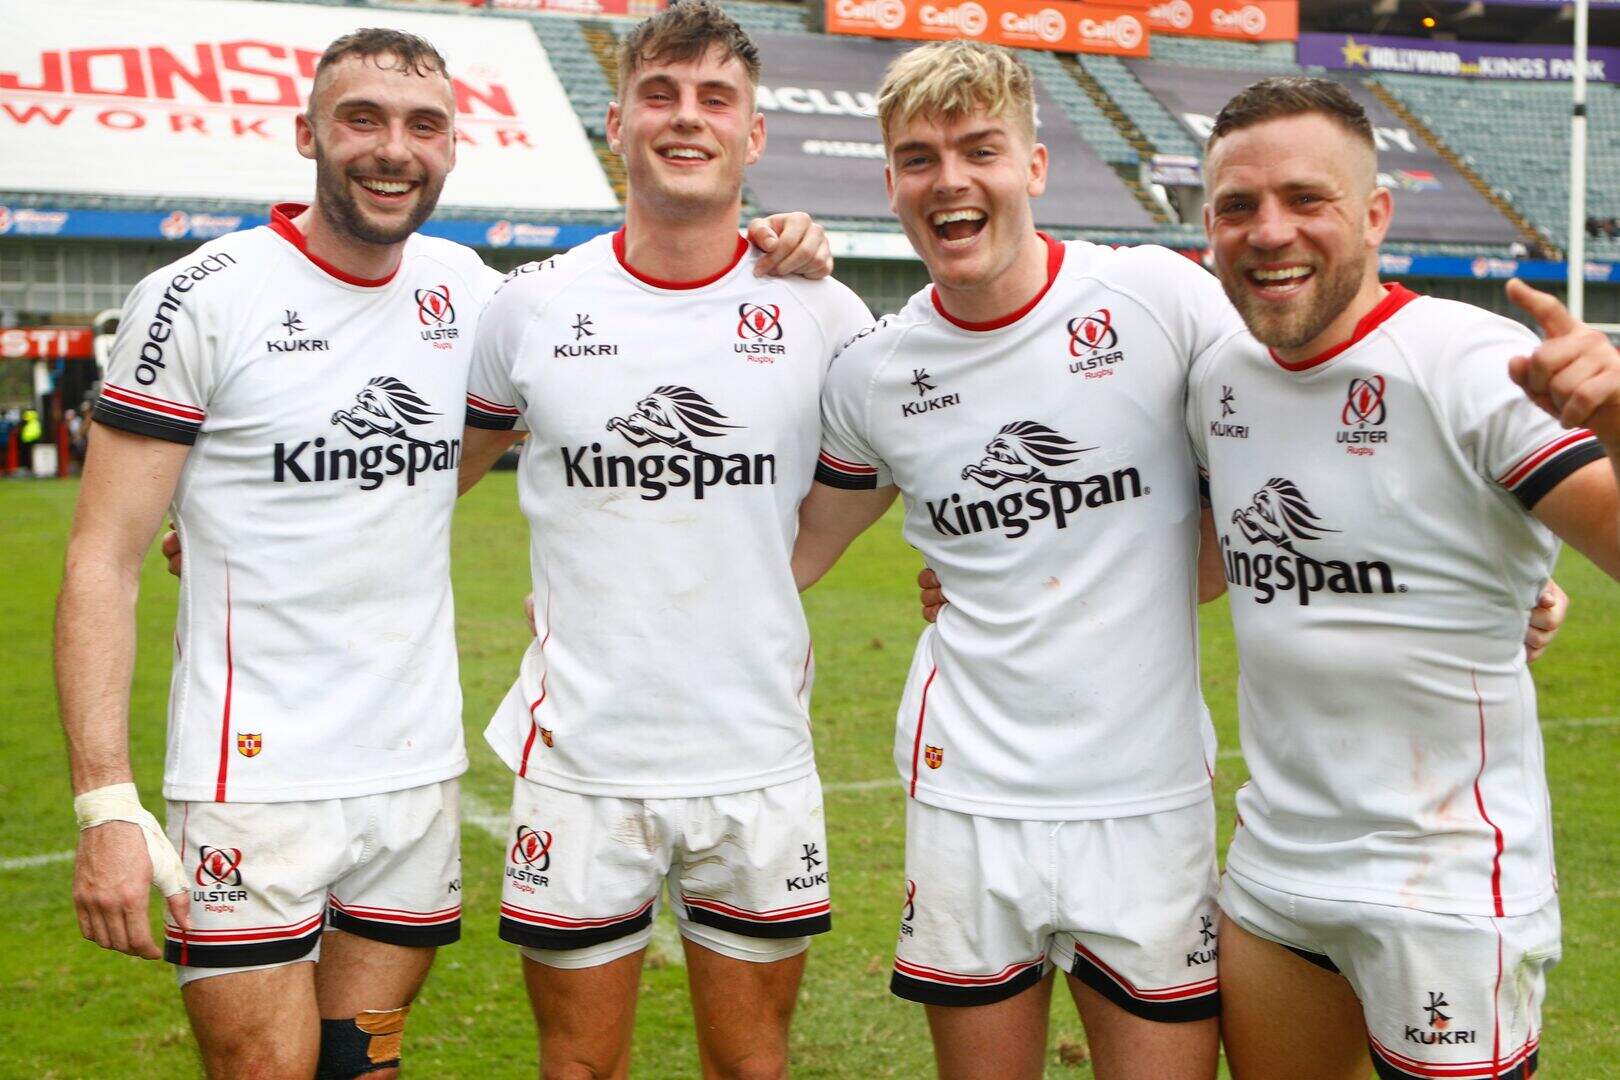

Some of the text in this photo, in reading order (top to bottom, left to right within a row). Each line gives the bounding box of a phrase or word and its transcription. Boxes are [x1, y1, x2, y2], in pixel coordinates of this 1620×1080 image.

[0, 40, 516, 117] JONSN
[1479, 57, 1547, 79] KINGS
[1550, 58, 1606, 80] PAK
[135, 252, 237, 386] openreach
[420, 328, 460, 341] ULSTER
[266, 339, 330, 352] KUKRI
[554, 344, 619, 358] KUKRI
[734, 342, 786, 356] ULSTER
[746, 354, 776, 365] Rugby
[1069, 350, 1124, 374] ULSTER
[1084, 368, 1114, 380] Rugby
[902, 392, 961, 417] KUKRI
[1210, 420, 1250, 438] KUKRI
[1336, 430, 1388, 443] ULSTER
[273, 436, 460, 491] Kingspan
[560, 441, 776, 501] Kingspan
[925, 464, 1141, 539] Kingspan
[1221, 534, 1396, 606] ingspan
[506, 866, 549, 887] ULSTER
[786, 871, 829, 892] KUK
[193, 890, 248, 902] ULSTER
[204, 903, 235, 914] Rugby
[1404, 1024, 1477, 1045] KUKRI
